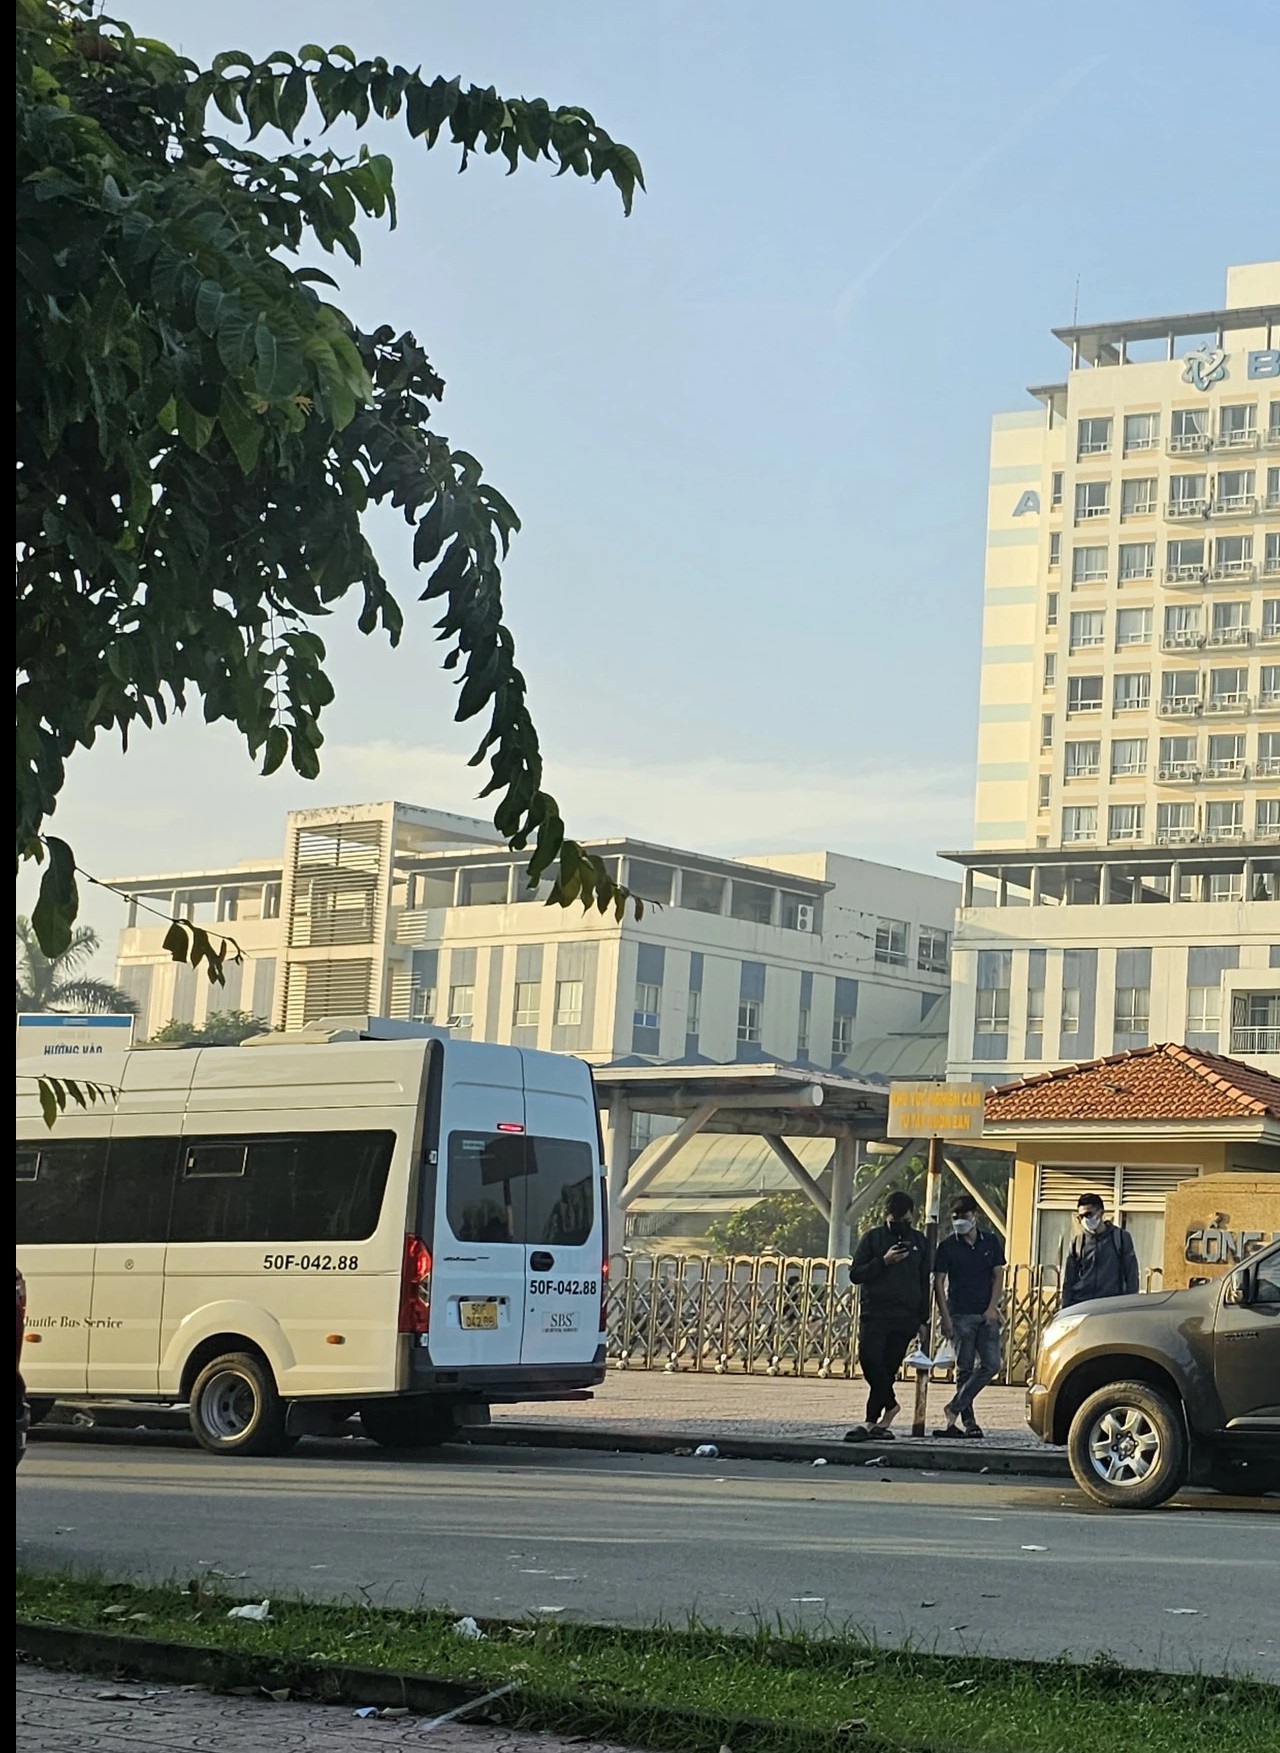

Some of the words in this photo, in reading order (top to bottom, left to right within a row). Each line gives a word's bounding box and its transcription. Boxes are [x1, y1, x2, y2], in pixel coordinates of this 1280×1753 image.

[1012, 490, 1041, 517] A
[263, 1254, 359, 1271] 50F-042.88
[529, 1279, 597, 1296] 50F-042.88
[24, 1315, 57, 1328] huttle
[60, 1316, 81, 1328] Bus
[84, 1316, 123, 1329] Service
[550, 1312, 574, 1327] SBS
